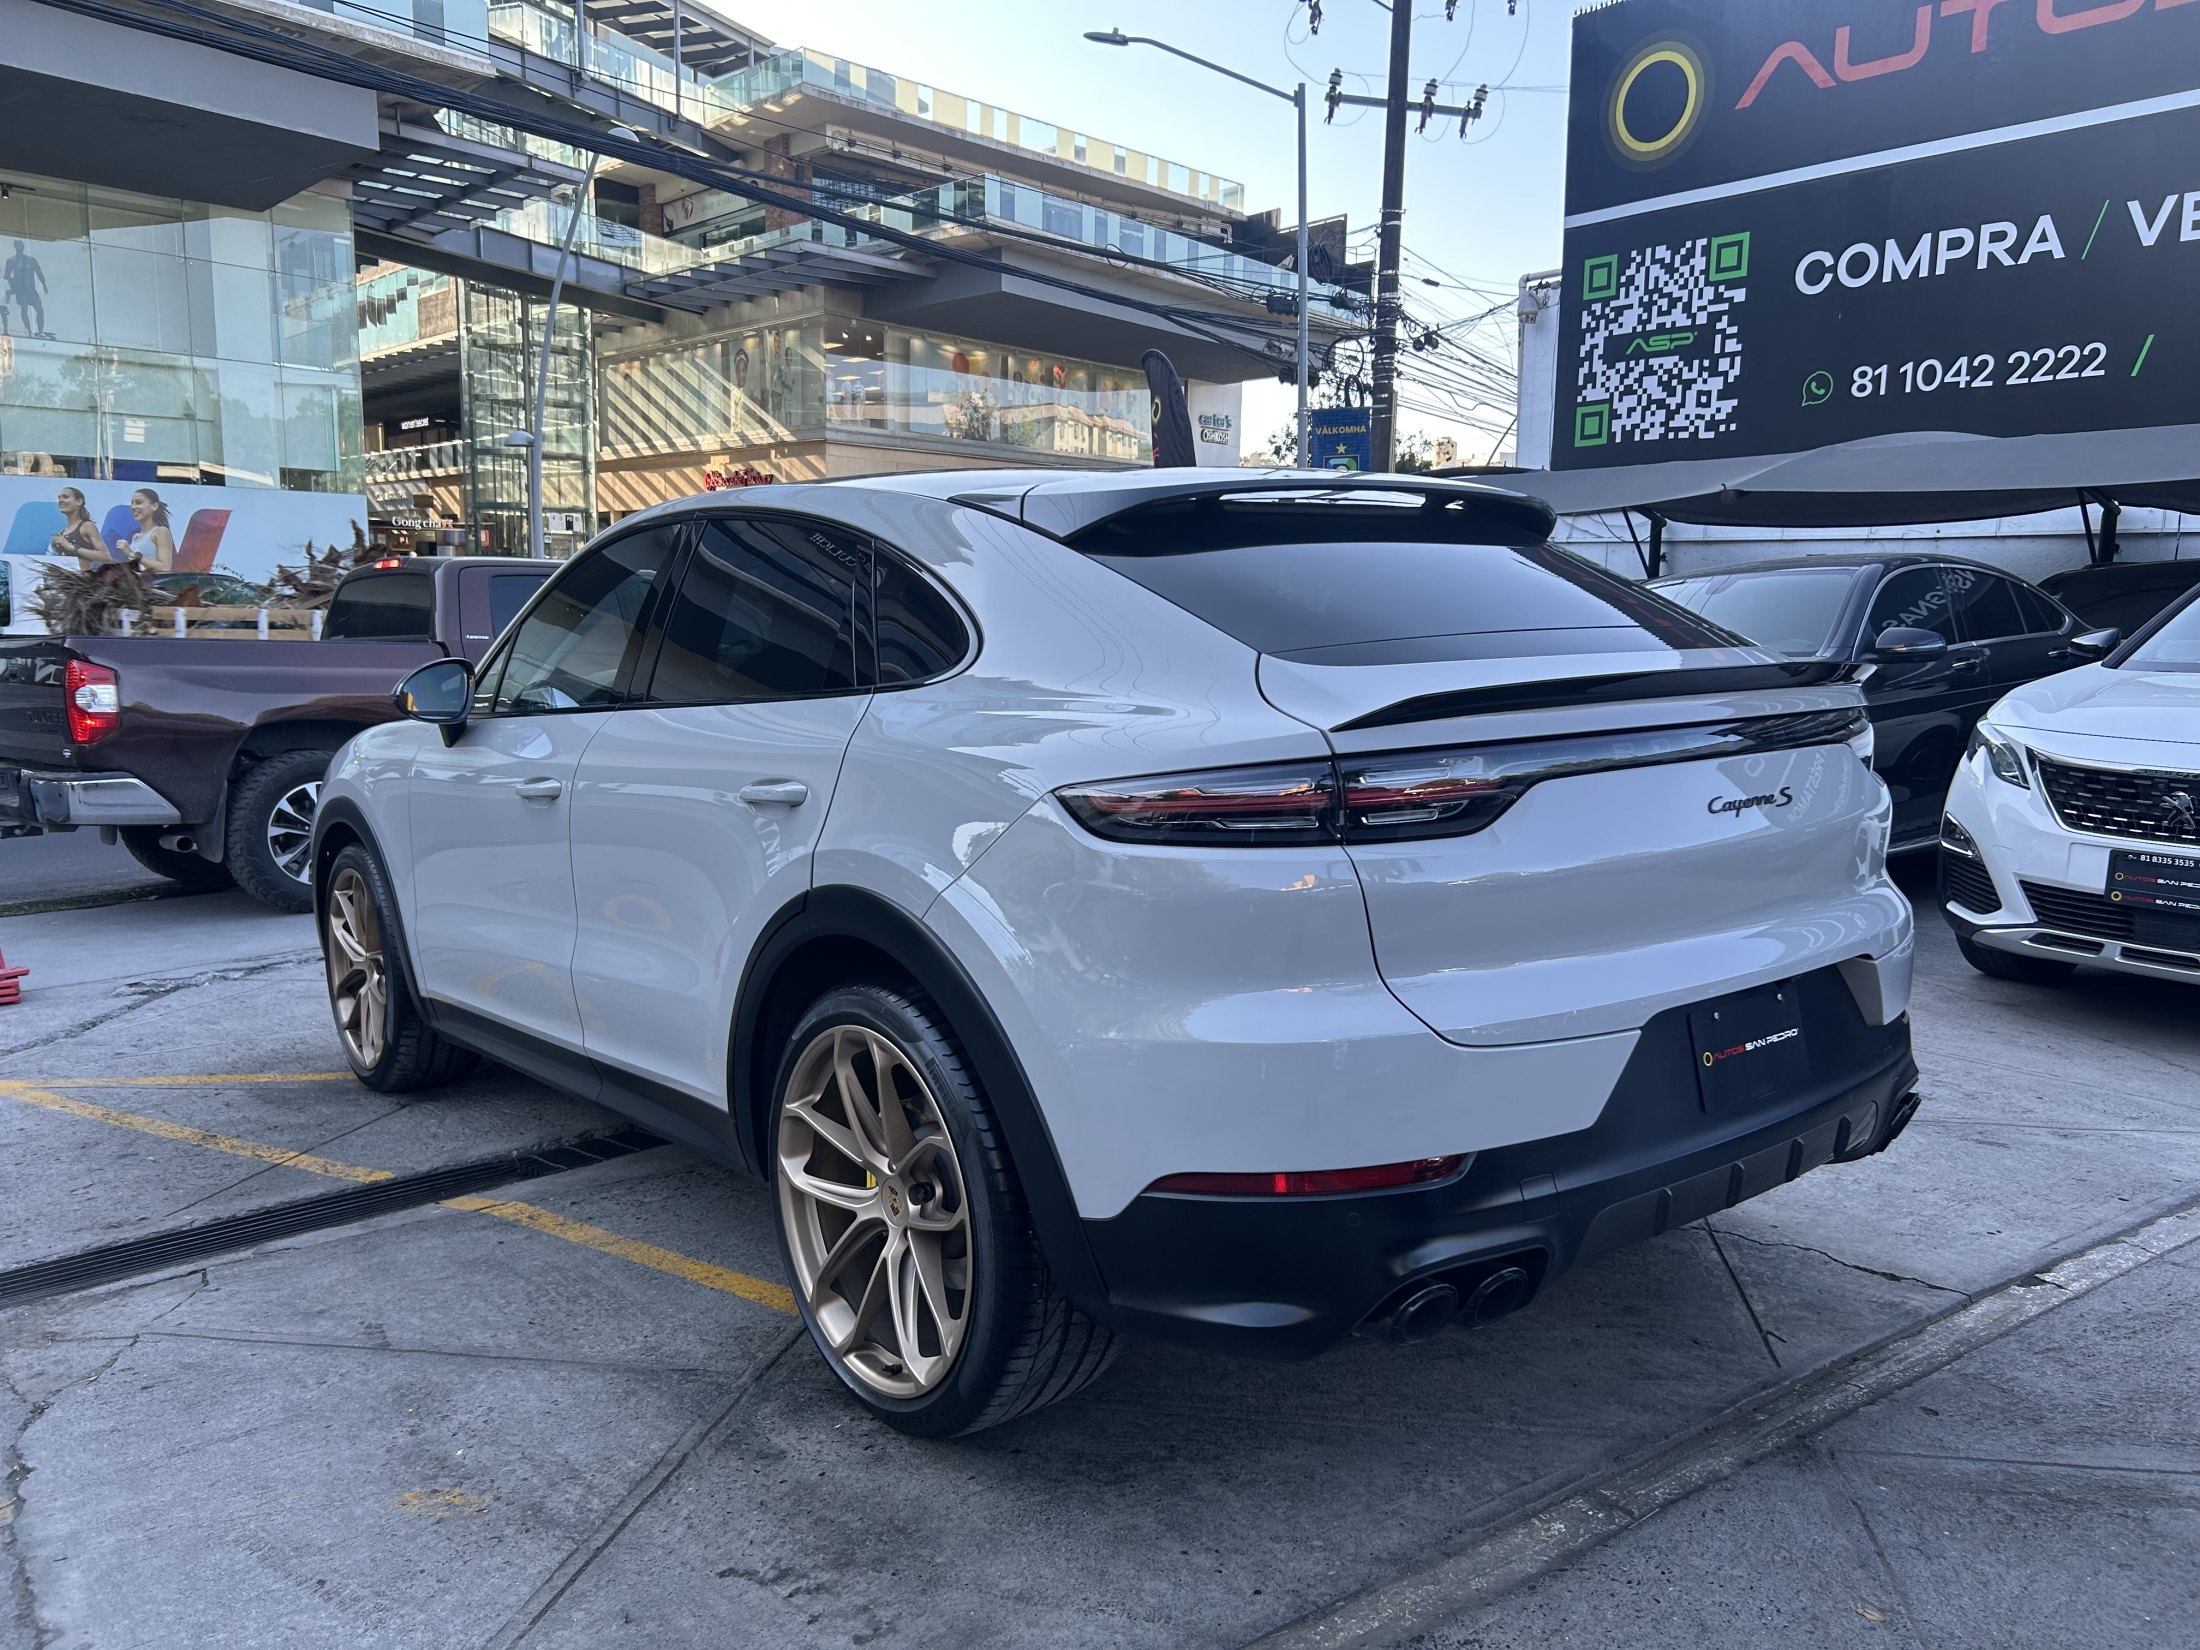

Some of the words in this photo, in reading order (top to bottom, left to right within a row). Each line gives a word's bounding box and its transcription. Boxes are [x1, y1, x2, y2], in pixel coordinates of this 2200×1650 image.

[1794, 213, 2066, 295] COMPRA
[1625, 332, 1694, 355] ASP
[1850, 364, 1888, 398] 81
[1899, 353, 1996, 394] 1042
[2005, 341, 2108, 386] 2222
[1315, 425, 1366, 435] VÄLKOMNA
[392, 516, 421, 530] Gong
[423, 517, 443, 528] cha
[1708, 796, 1777, 818] Cayenne
[1775, 786, 1793, 807] S
[2140, 854, 2150, 862] 81
[2151, 856, 2172, 865] 8335
[2173, 858, 2195, 867] 3535
[2157, 878, 2179, 886] SAN
[2155, 899, 2177, 907] SAN
[1713, 1045, 1745, 1061] AUTOS
[1745, 1038, 1766, 1051] SAN
[1766, 1028, 1799, 1044] PEDRO
